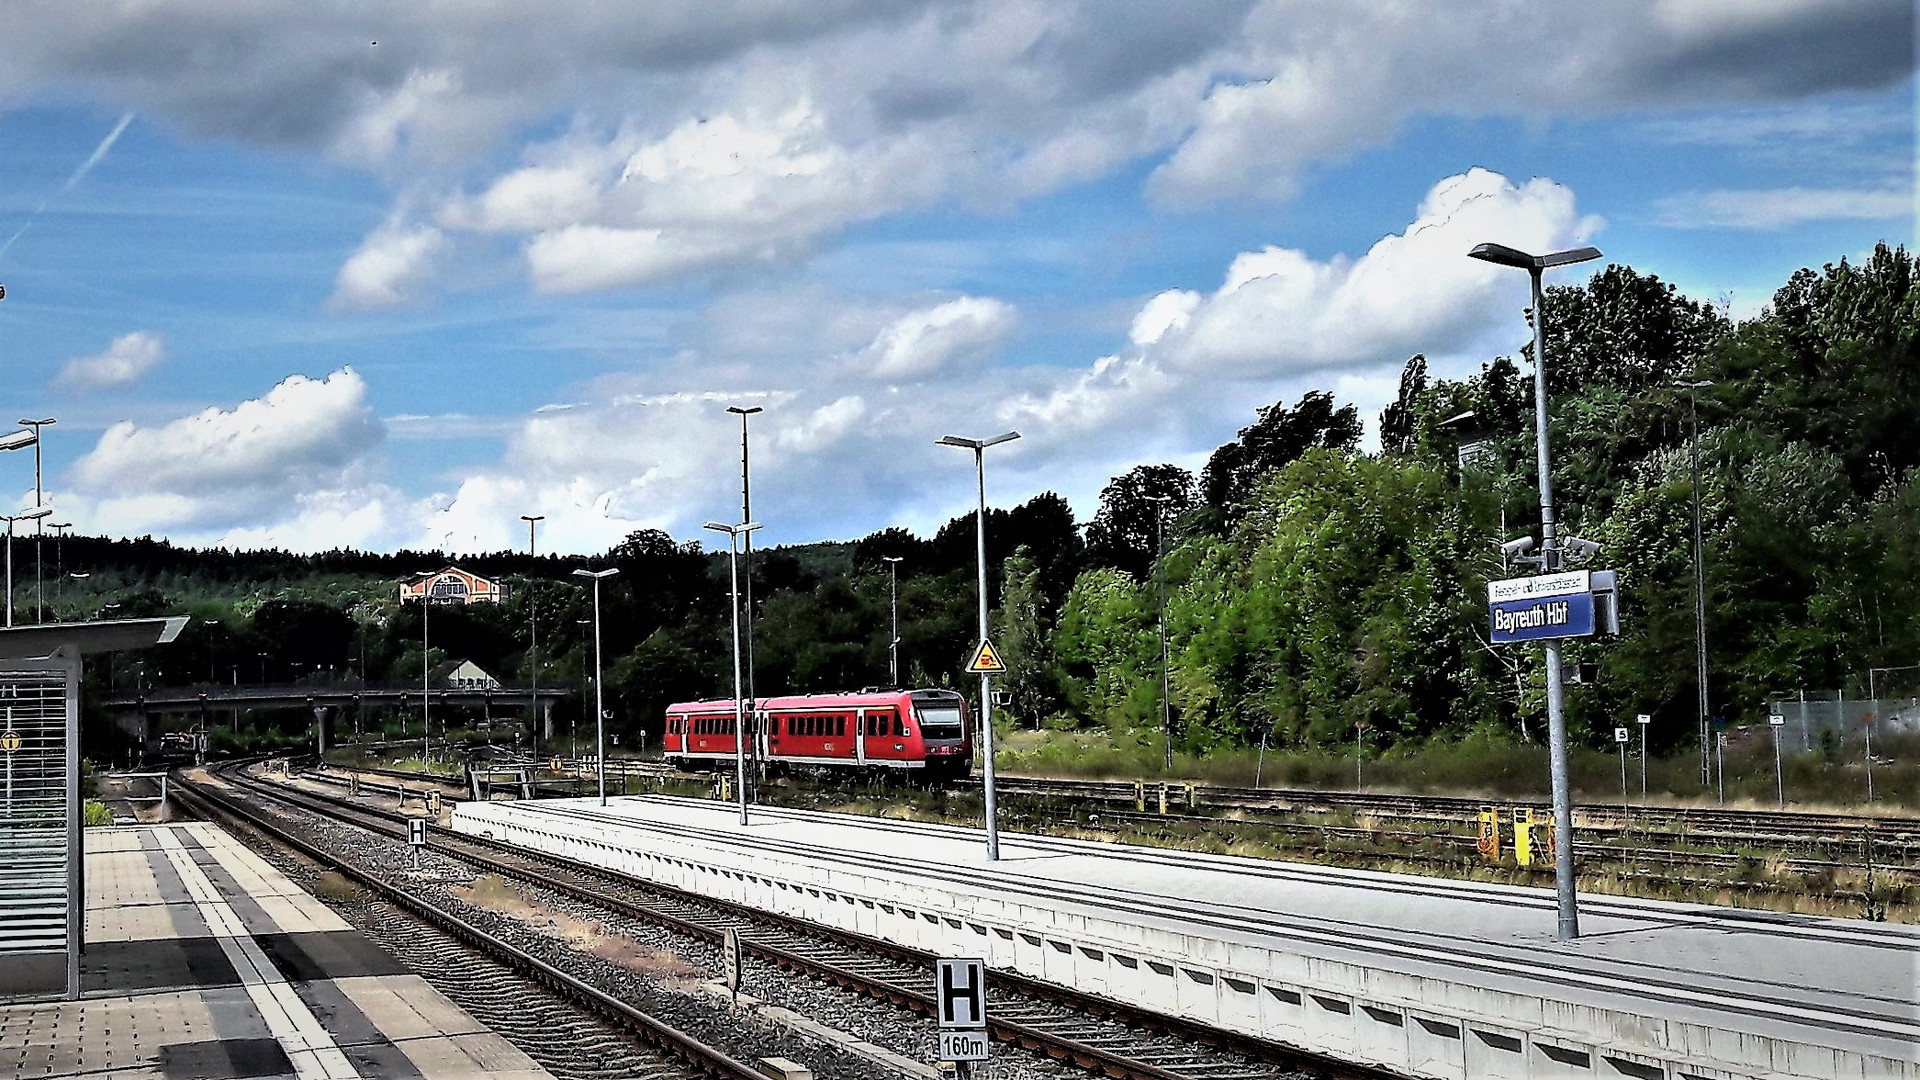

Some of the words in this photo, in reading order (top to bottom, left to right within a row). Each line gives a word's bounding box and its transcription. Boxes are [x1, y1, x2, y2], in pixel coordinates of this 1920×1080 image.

[1495, 604, 1545, 634] Bayreuth
[1547, 601, 1568, 625] Hbf
[410, 820, 424, 843] H
[942, 964, 981, 1022] H
[943, 1035, 984, 1057] 160m
